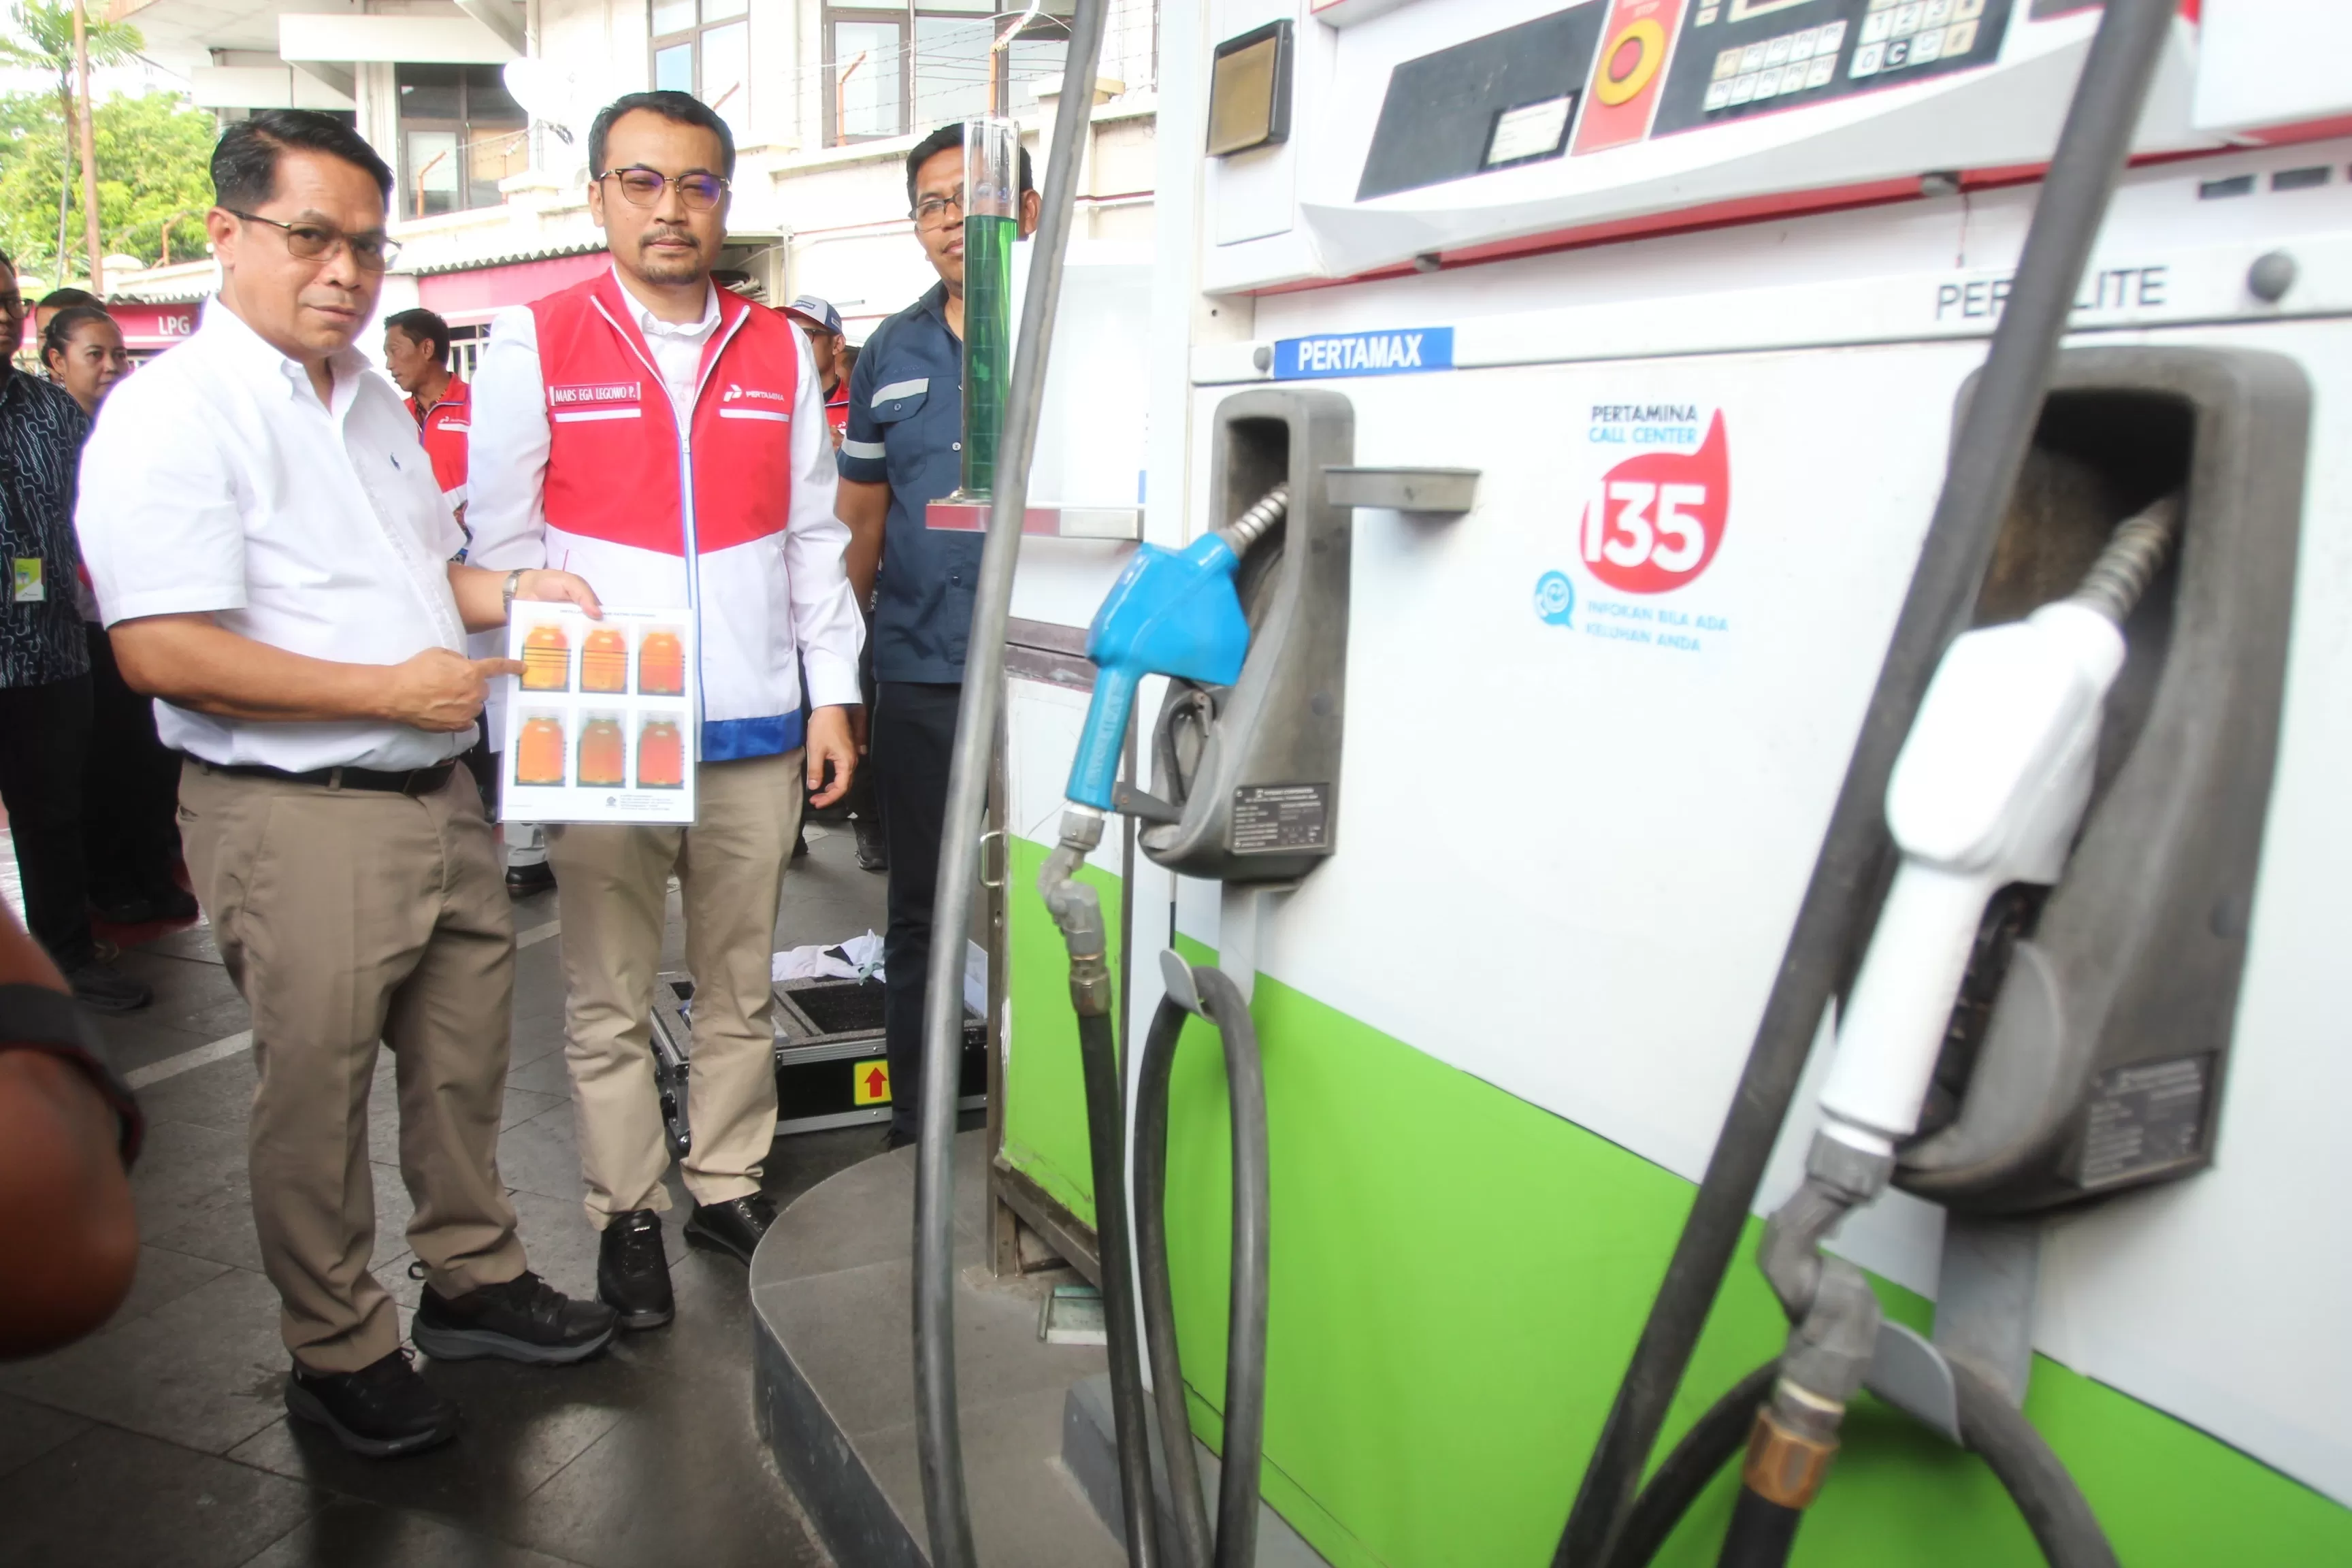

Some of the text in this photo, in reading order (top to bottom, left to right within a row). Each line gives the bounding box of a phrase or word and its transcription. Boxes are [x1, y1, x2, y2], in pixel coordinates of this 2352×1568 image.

[1886, 42, 1908, 65] C
[1936, 265, 2168, 321] PERITE
[158, 316, 190, 336] LPG
[1298, 334, 1423, 372] PERTAMAX
[555, 385, 636, 402] MARS EGA LEGOWO P.
[745, 390, 785, 402] PERTAMINA
[1591, 404, 1699, 423] PERTAMINA
[1588, 427, 1697, 444] CALL CENTER
[1584, 480, 1706, 572] 135
[1695, 614, 1729, 632] ADA
